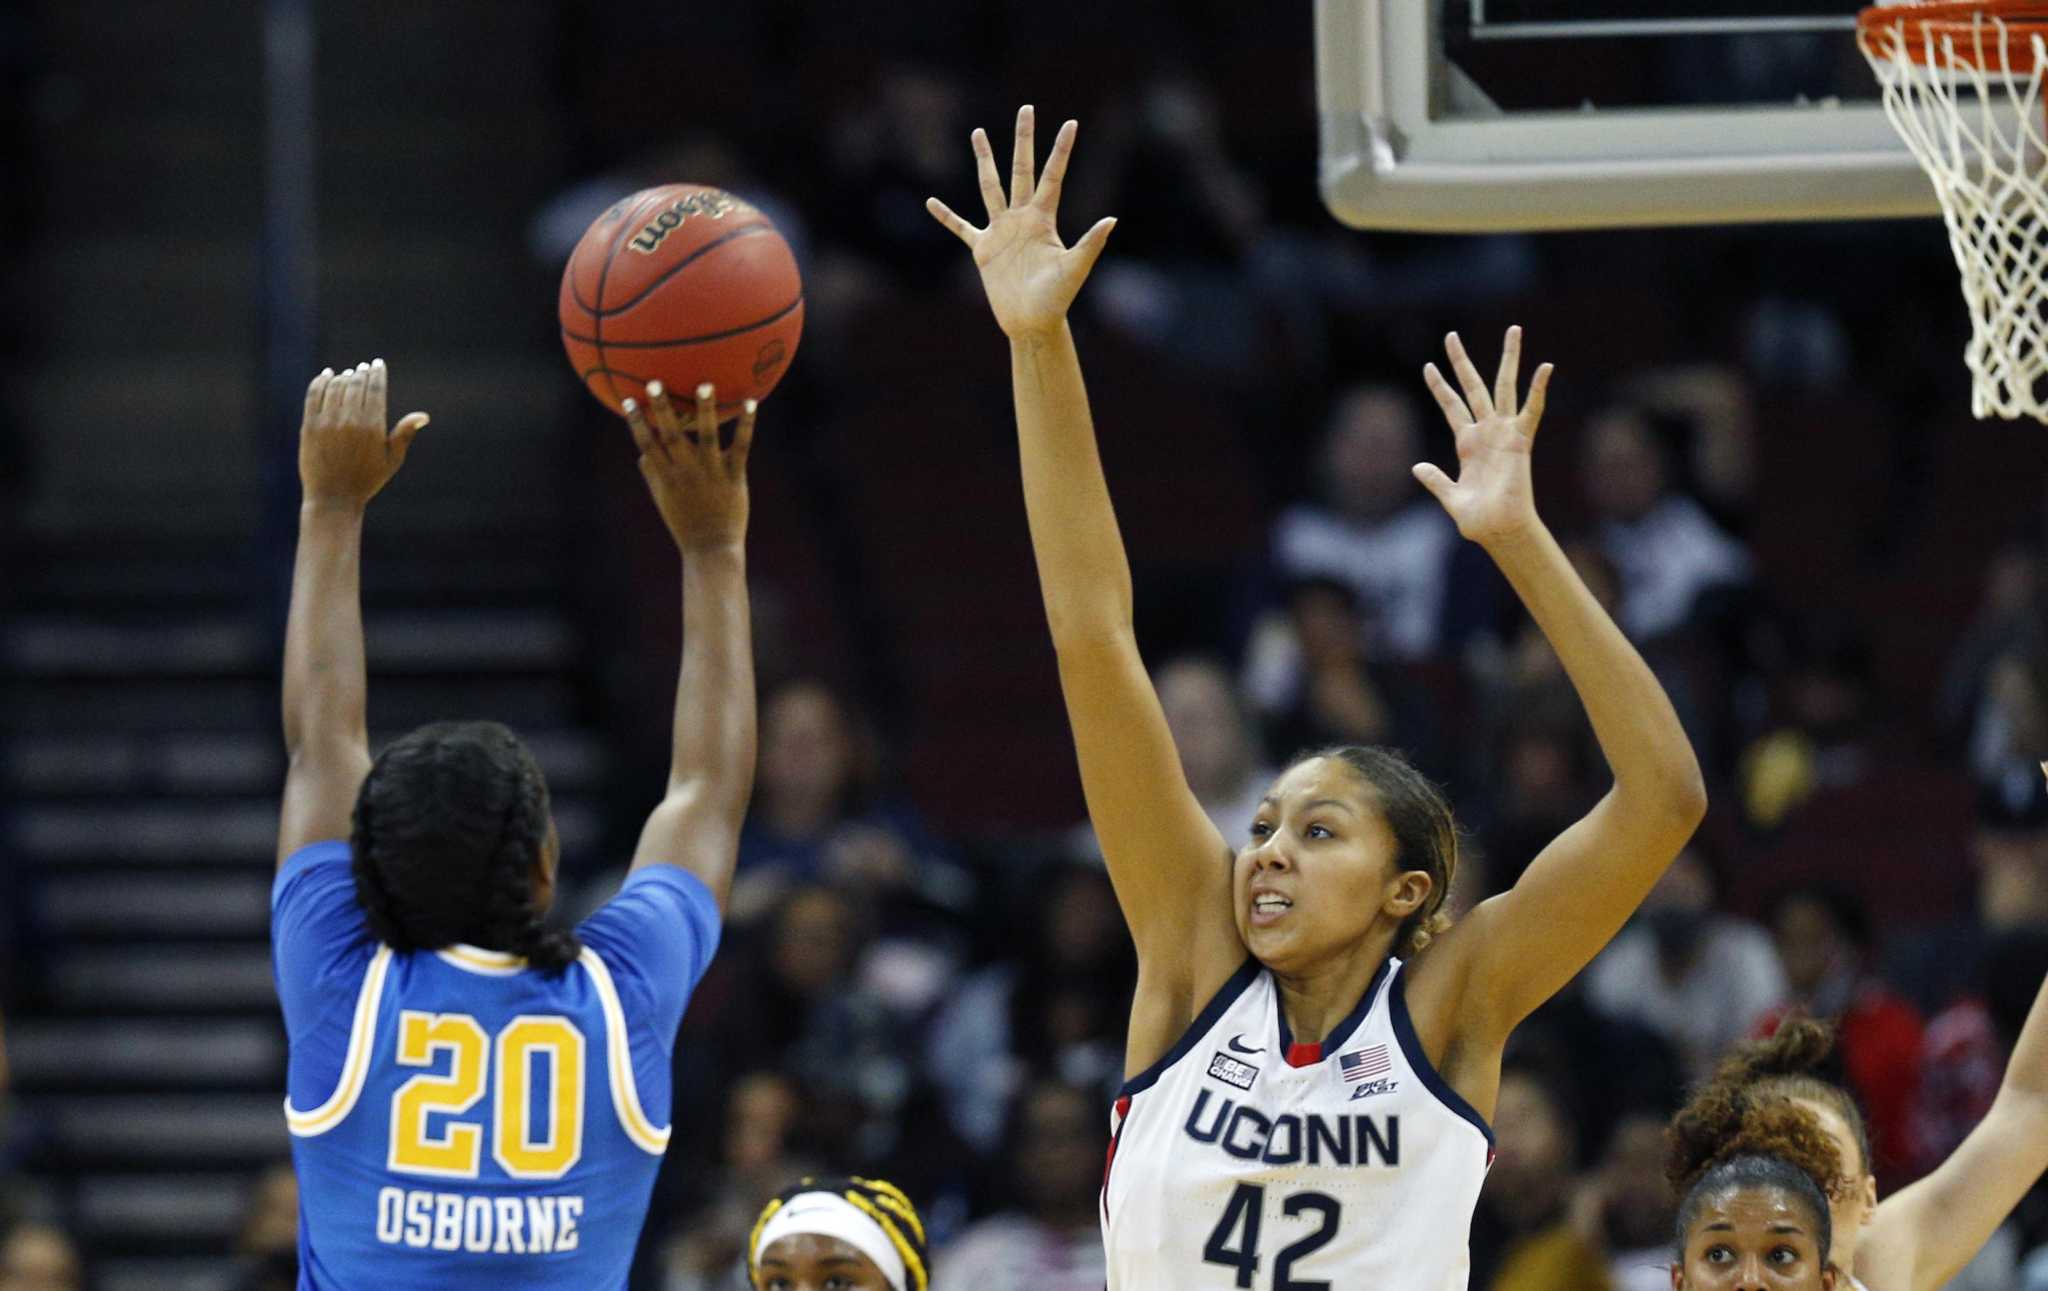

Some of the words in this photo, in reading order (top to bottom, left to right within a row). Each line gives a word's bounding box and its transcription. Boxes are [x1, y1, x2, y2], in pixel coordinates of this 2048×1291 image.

[387, 1011, 586, 1179] 20
[1184, 1087, 1399, 1166] UCONN
[376, 1186, 584, 1255] OSBORNE
[1203, 1180, 1341, 1291] 42
